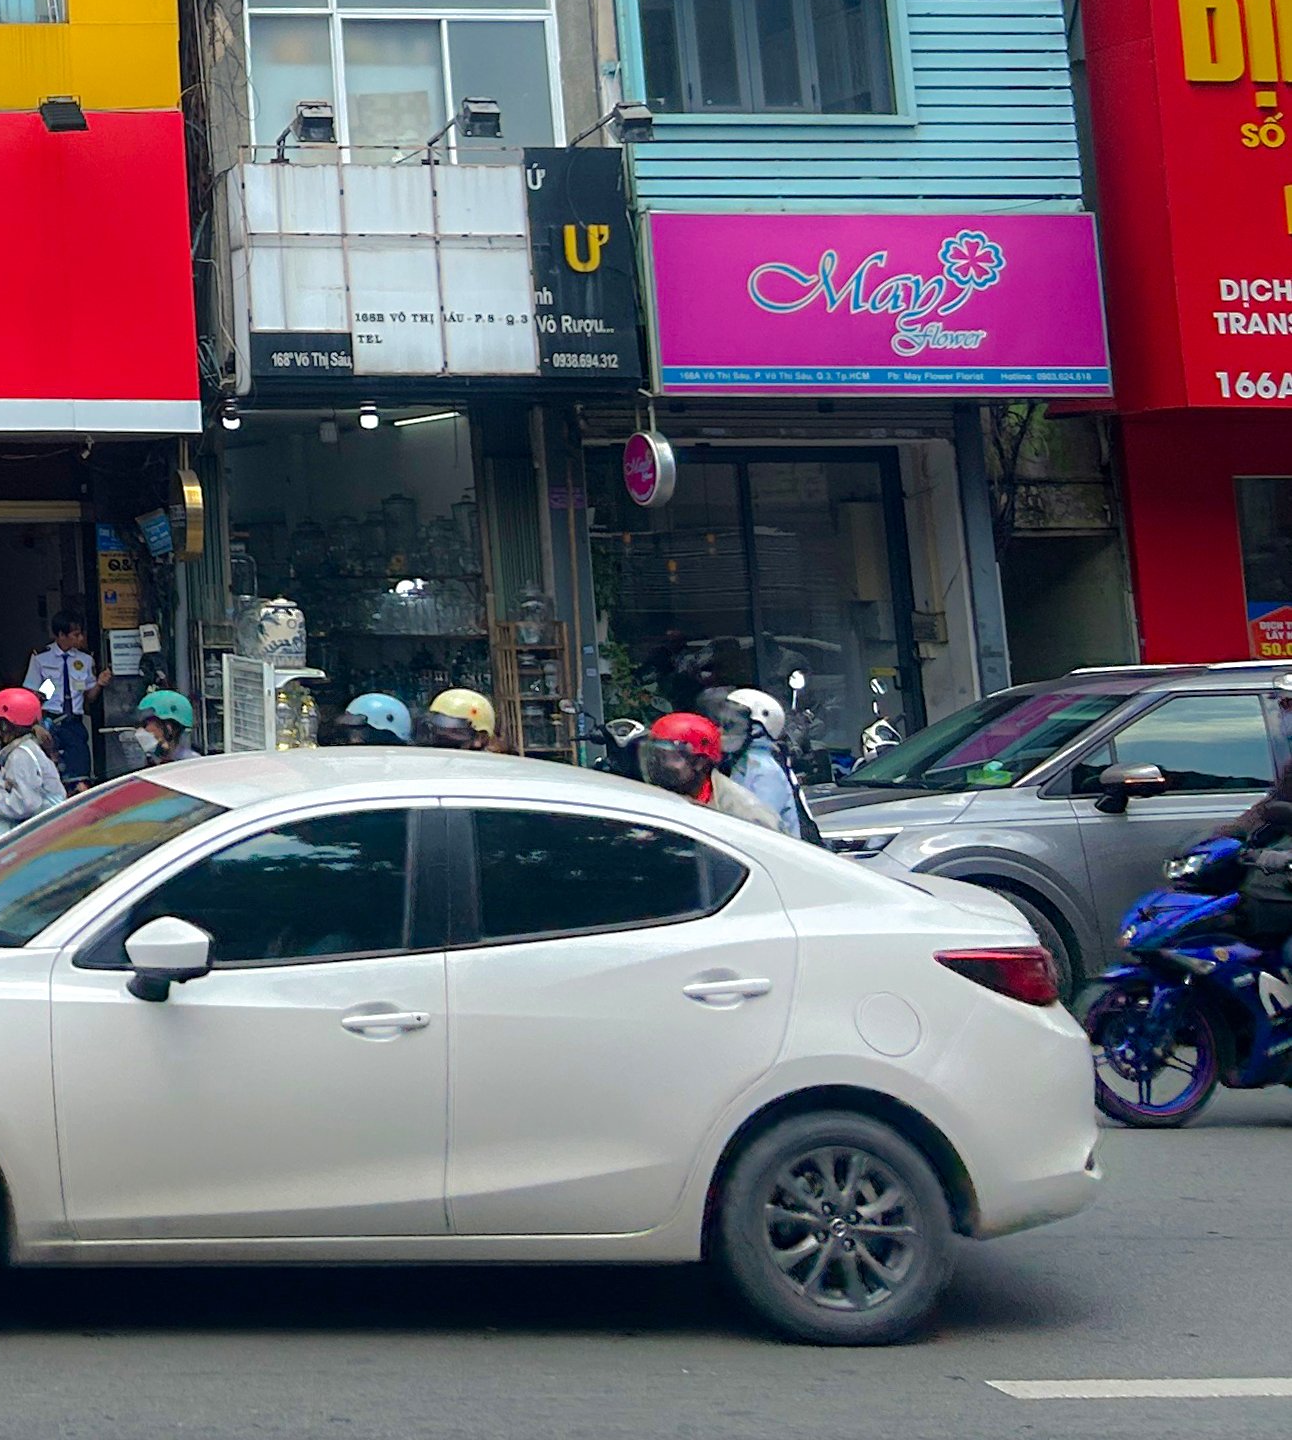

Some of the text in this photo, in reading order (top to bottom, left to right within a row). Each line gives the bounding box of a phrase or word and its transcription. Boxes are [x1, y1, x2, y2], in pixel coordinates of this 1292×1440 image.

[1241, 112, 1285, 148] SỐ
[747, 249, 947, 332] May
[1219, 278, 1292, 309] DỊCH
